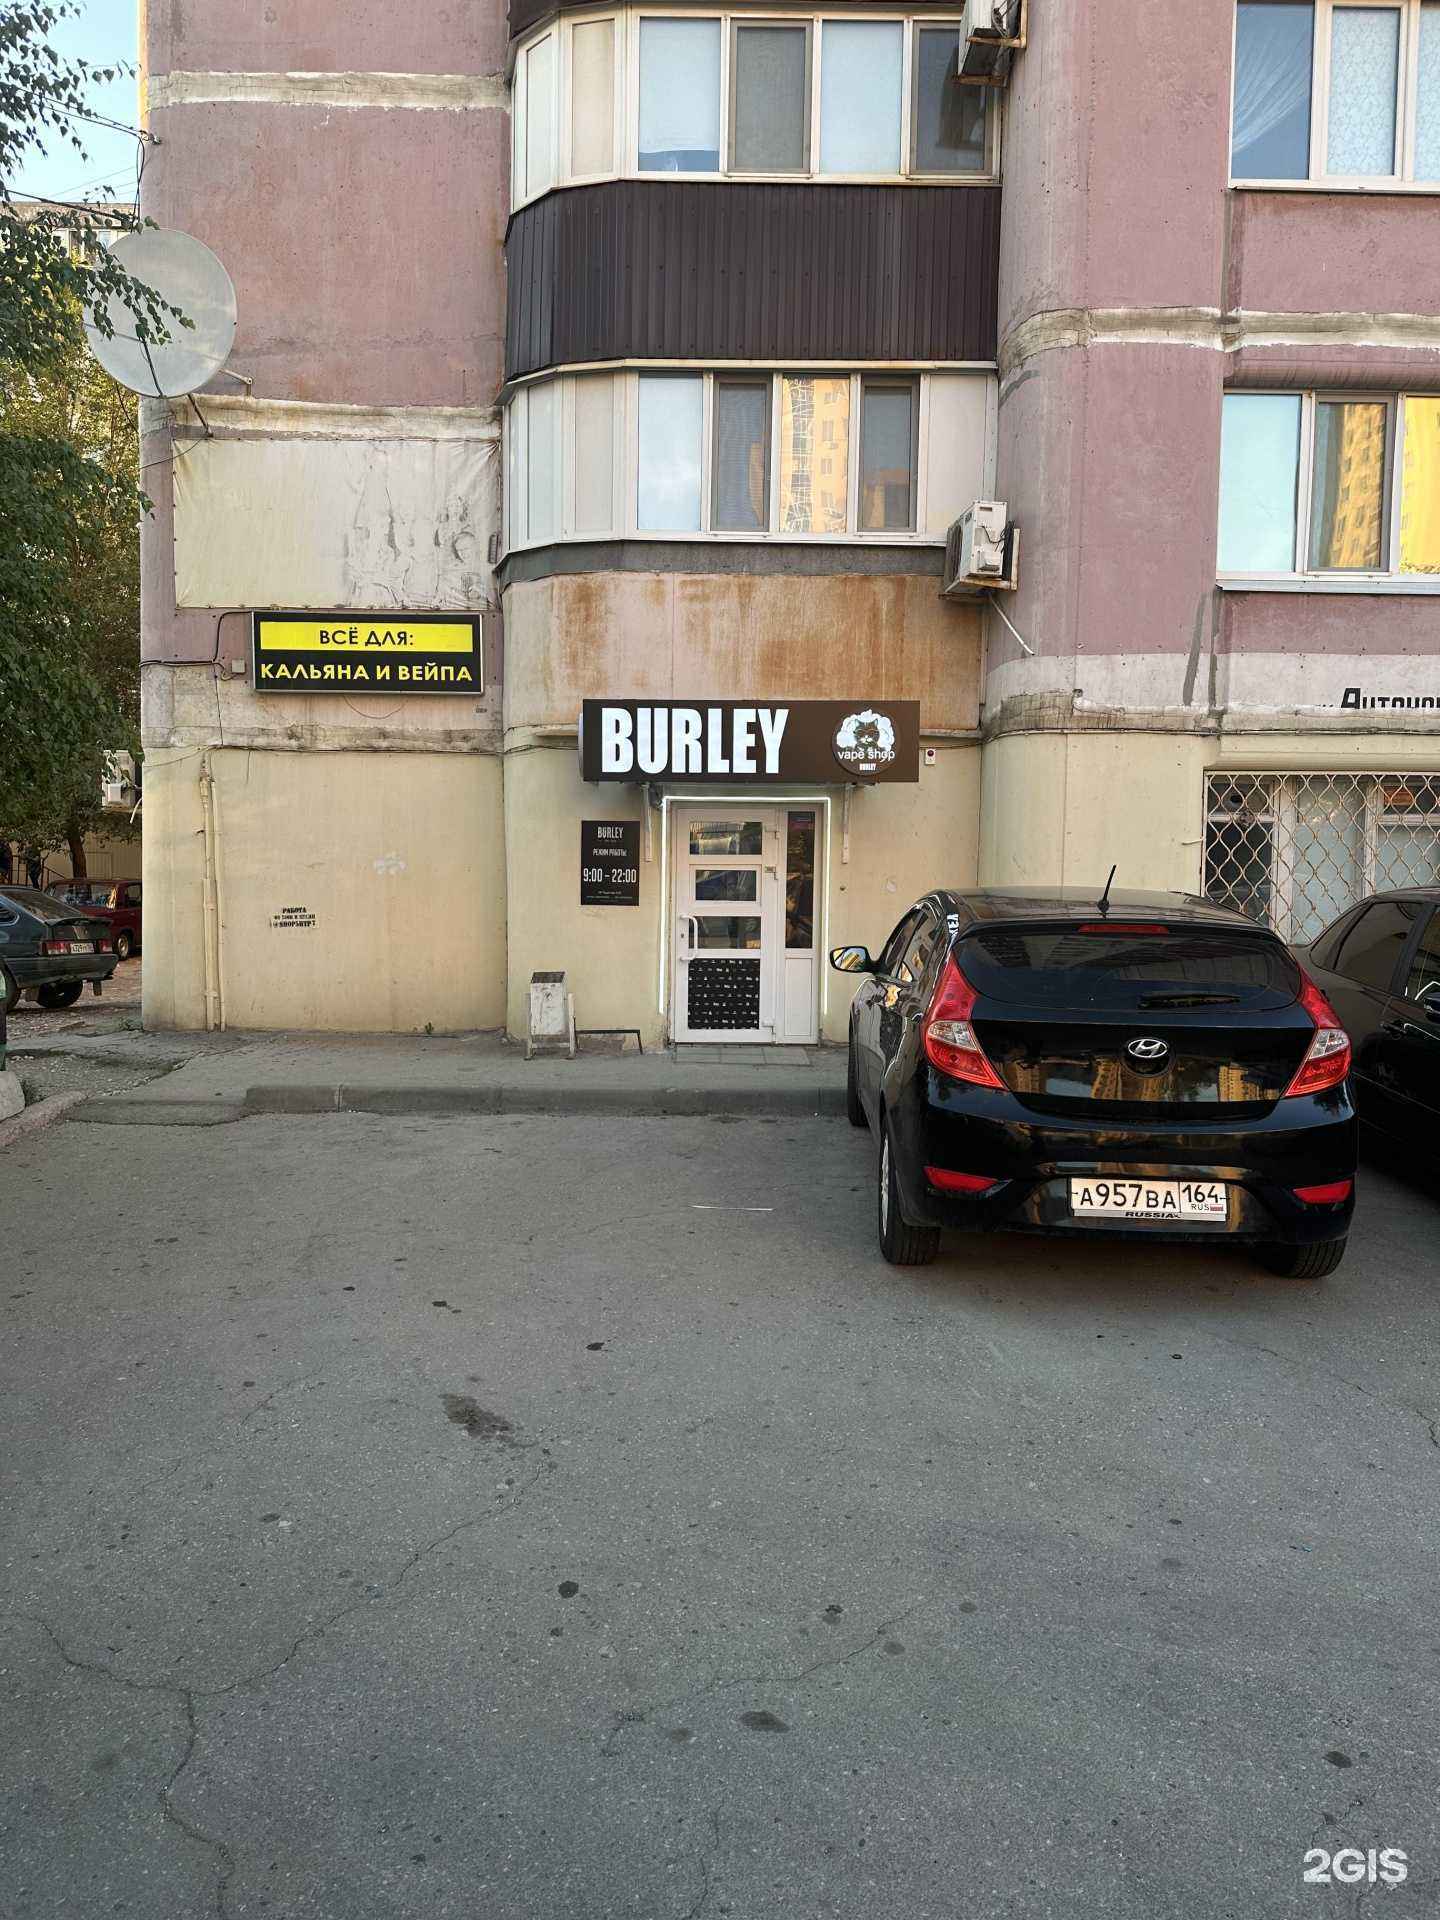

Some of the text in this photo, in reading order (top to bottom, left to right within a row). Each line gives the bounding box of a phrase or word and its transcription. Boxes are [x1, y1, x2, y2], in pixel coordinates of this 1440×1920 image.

[319, 627, 414, 647] ВСЁ ДЛЯ:
[261, 662, 473, 681] КАЛЬЯНА И ВЕЙПА
[601, 707, 789, 774] BURLEY
[837, 748, 896, 763] vape shop
[597, 826, 624, 839] BURLEY
[583, 868, 603, 882] 9:00
[611, 868, 637, 883] 22:00
[1182, 1184, 1219, 1204] 164
[1191, 1203, 1210, 1211] RUS
[1125, 1211, 1175, 1219] RUSSIA
